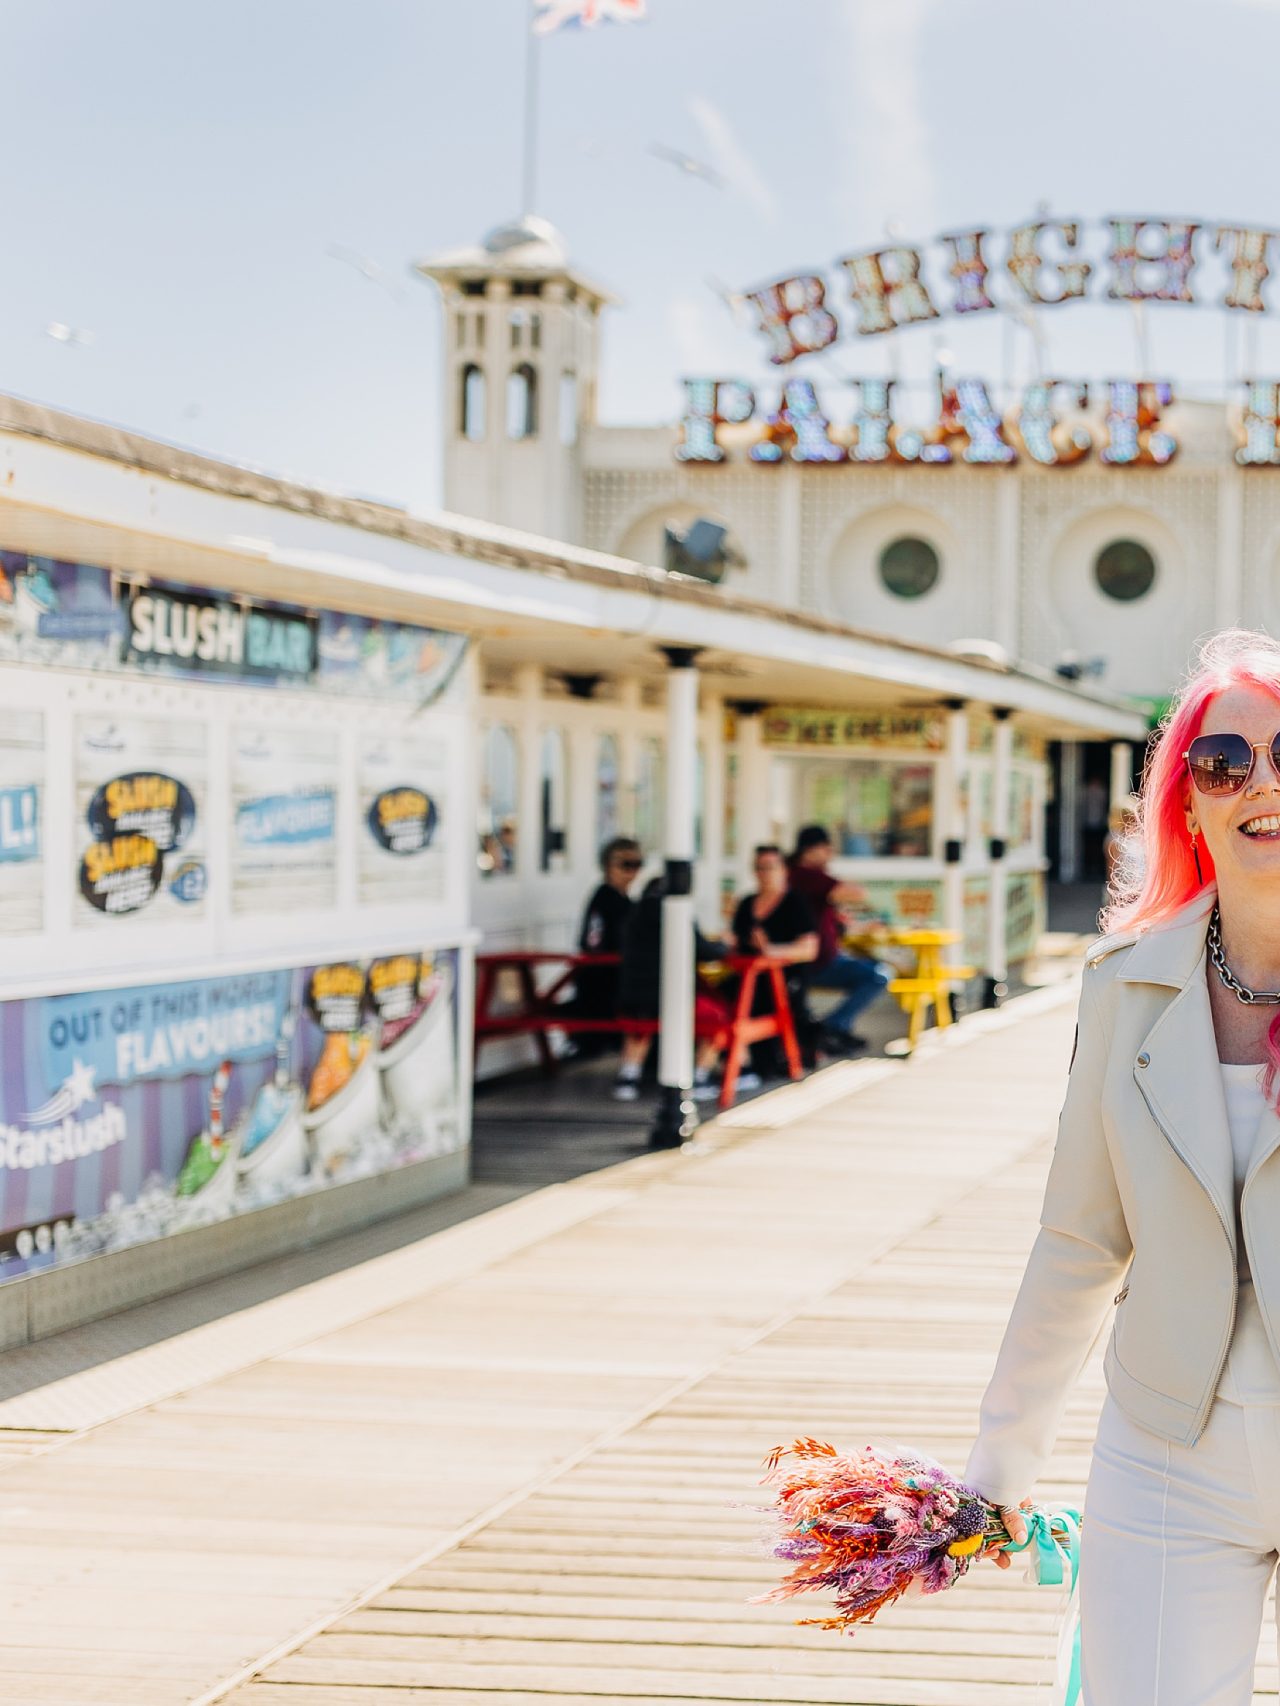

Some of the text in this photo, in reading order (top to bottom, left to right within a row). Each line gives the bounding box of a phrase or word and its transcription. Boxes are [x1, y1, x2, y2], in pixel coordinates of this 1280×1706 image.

[675, 378, 1178, 466] PALACE
[131, 595, 243, 665] SLUSH
[247, 612, 312, 674] BAR
[50, 1007, 102, 1048] OUT
[111, 999, 142, 1033] OF
[152, 991, 201, 1024] THIS
[115, 1002, 276, 1080] FLAVOURS!
